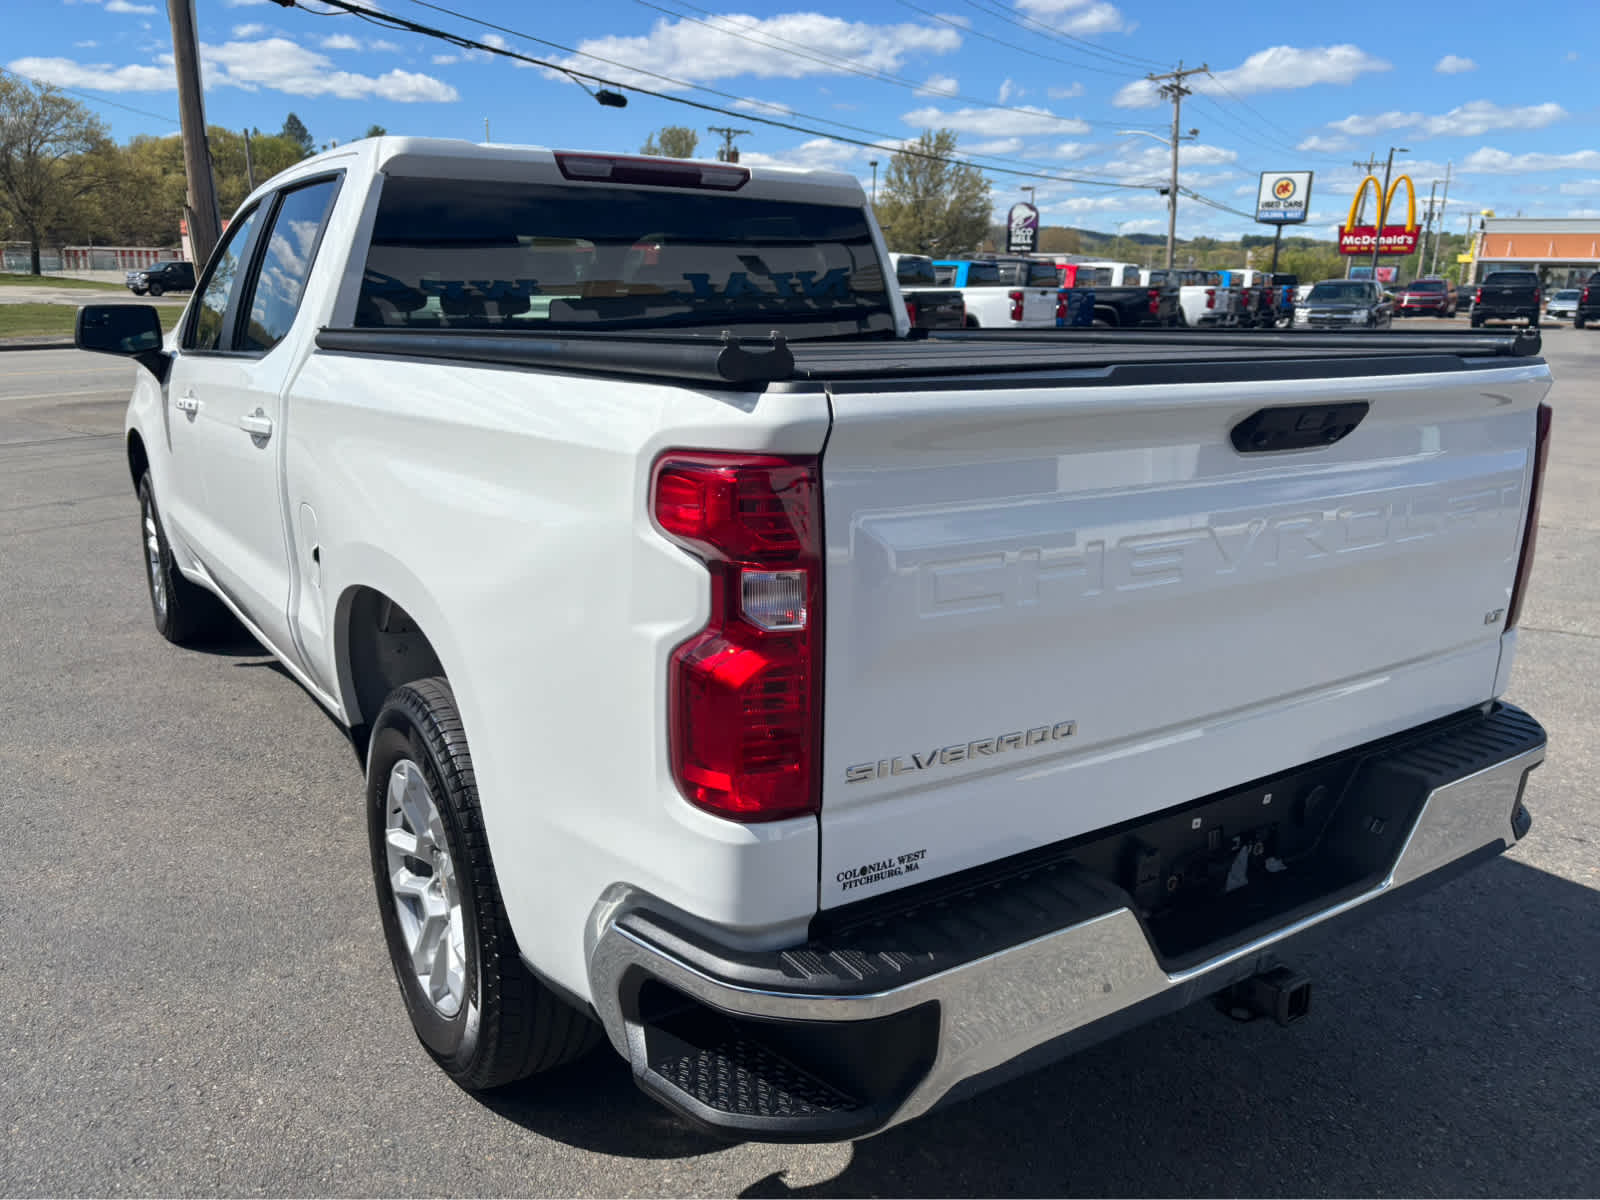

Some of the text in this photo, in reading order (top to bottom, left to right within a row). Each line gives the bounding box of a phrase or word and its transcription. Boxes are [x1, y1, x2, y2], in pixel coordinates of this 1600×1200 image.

[1261, 200, 1303, 208] USED CARS
[1010, 228, 1034, 236] TACO
[1011, 236, 1033, 244] BELL
[1484, 608, 1505, 624] LT
[845, 719, 1079, 784] SILVERADO
[837, 849, 927, 882] COLONIAL WEST
[904, 862, 920, 873] MA
